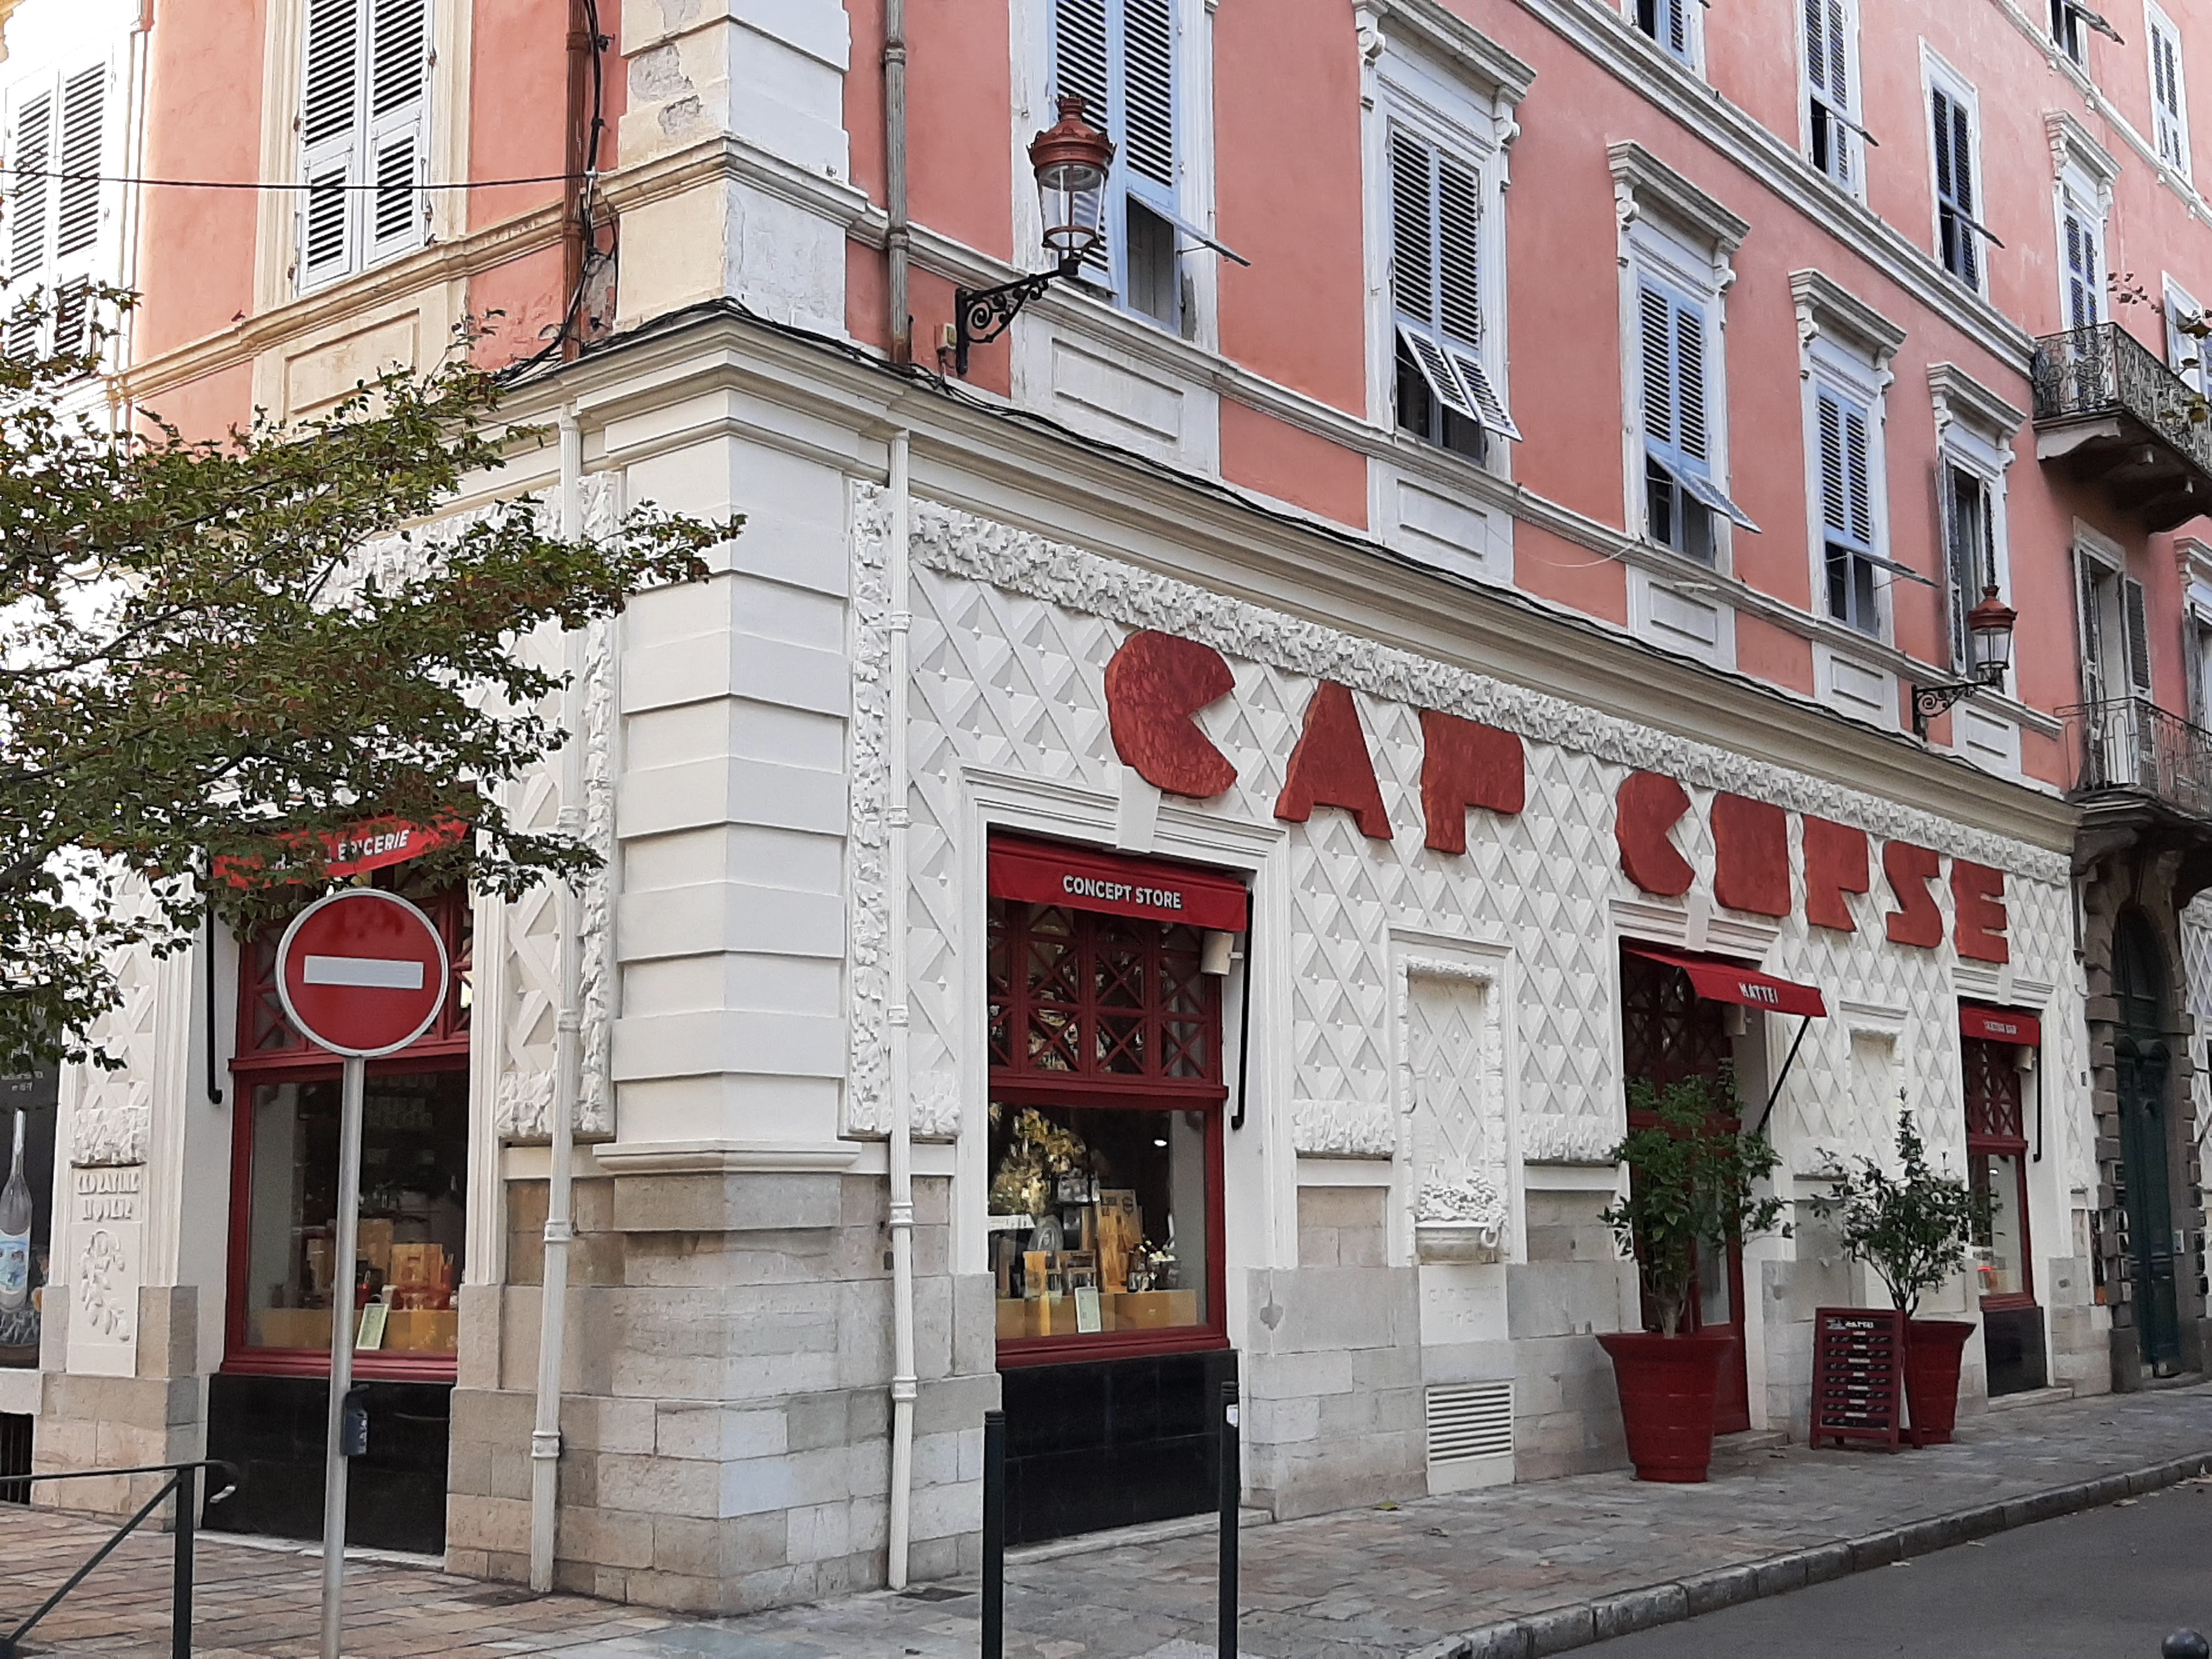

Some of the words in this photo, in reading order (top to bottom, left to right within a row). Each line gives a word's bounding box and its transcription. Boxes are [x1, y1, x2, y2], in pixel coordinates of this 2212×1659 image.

[1104, 629, 1525, 855] CAP
[1615, 769, 2010, 964] CORSE
[1063, 874, 1132, 902] CONCEPT
[1136, 887, 1182, 909] STORE
[1737, 982, 1778, 1003] MATTEI
